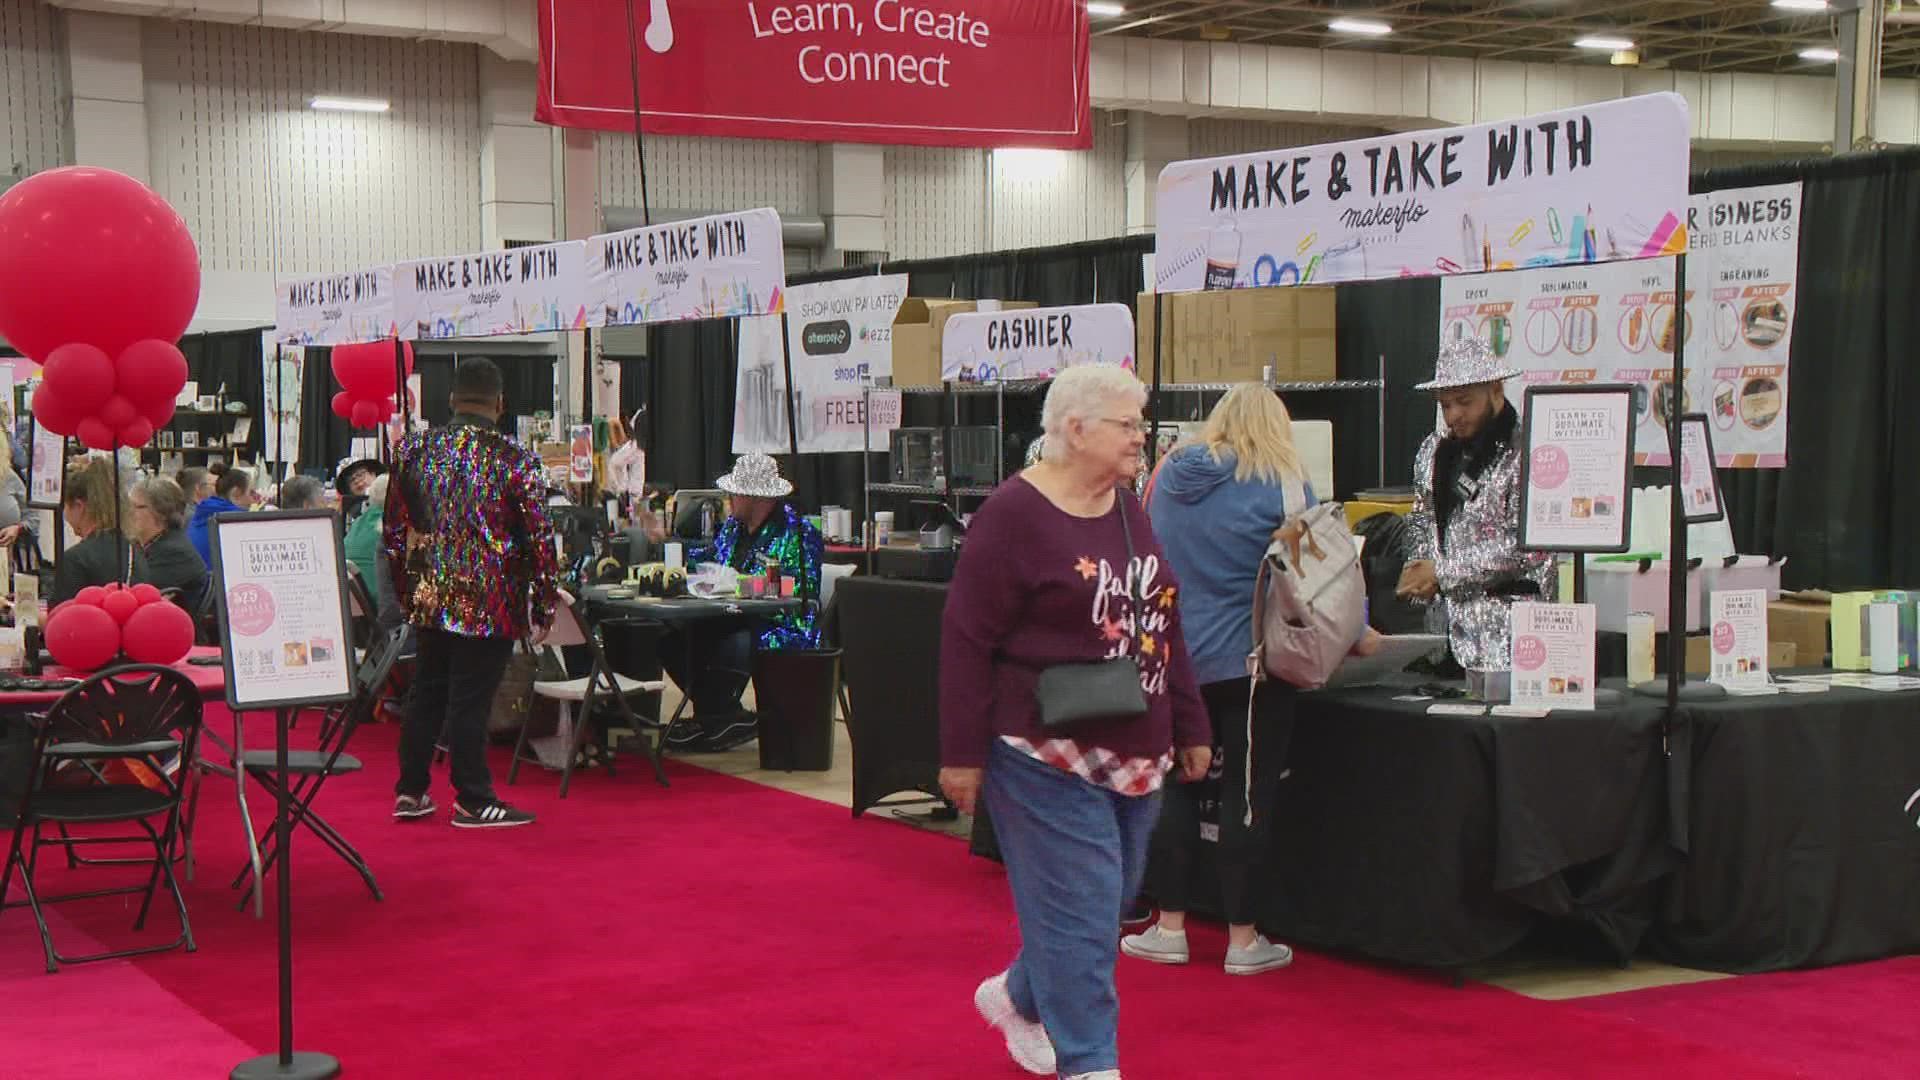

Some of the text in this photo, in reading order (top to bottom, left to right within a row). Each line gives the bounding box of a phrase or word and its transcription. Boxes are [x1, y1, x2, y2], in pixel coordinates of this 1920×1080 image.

[748, 0, 991, 48] Learn, Create
[797, 45, 951, 88] Connect
[1209, 114, 1593, 212] MAKE & TAKE WITH
[1340, 198, 1430, 233] makerflo
[604, 219, 747, 272] MAKE & TAKE WITH
[1722, 224, 1793, 246] BLANKS
[415, 247, 558, 293] MAKE & TAKE WITH
[1719, 268, 1770, 282] ENGRAVING
[289, 271, 377, 309] MAKE & TAKE WITH
[1541, 279, 1588, 293] SUBLIMATION
[1751, 287, 1780, 296] AFTER
[801, 300, 829, 318] SHOP
[870, 294, 899, 311] LATER
[987, 313, 1073, 351] CASHIER
[834, 366, 856, 383] shop
[1747, 368, 1776, 377] AFTER
[825, 400, 865, 425] FREE
[249, 543, 286, 552] LEARN
[249, 551, 308, 564] SUBLIMATE
[251, 563, 284, 573] WITH
[1092, 555, 1162, 624] fall
[1141, 605, 1170, 633] in
